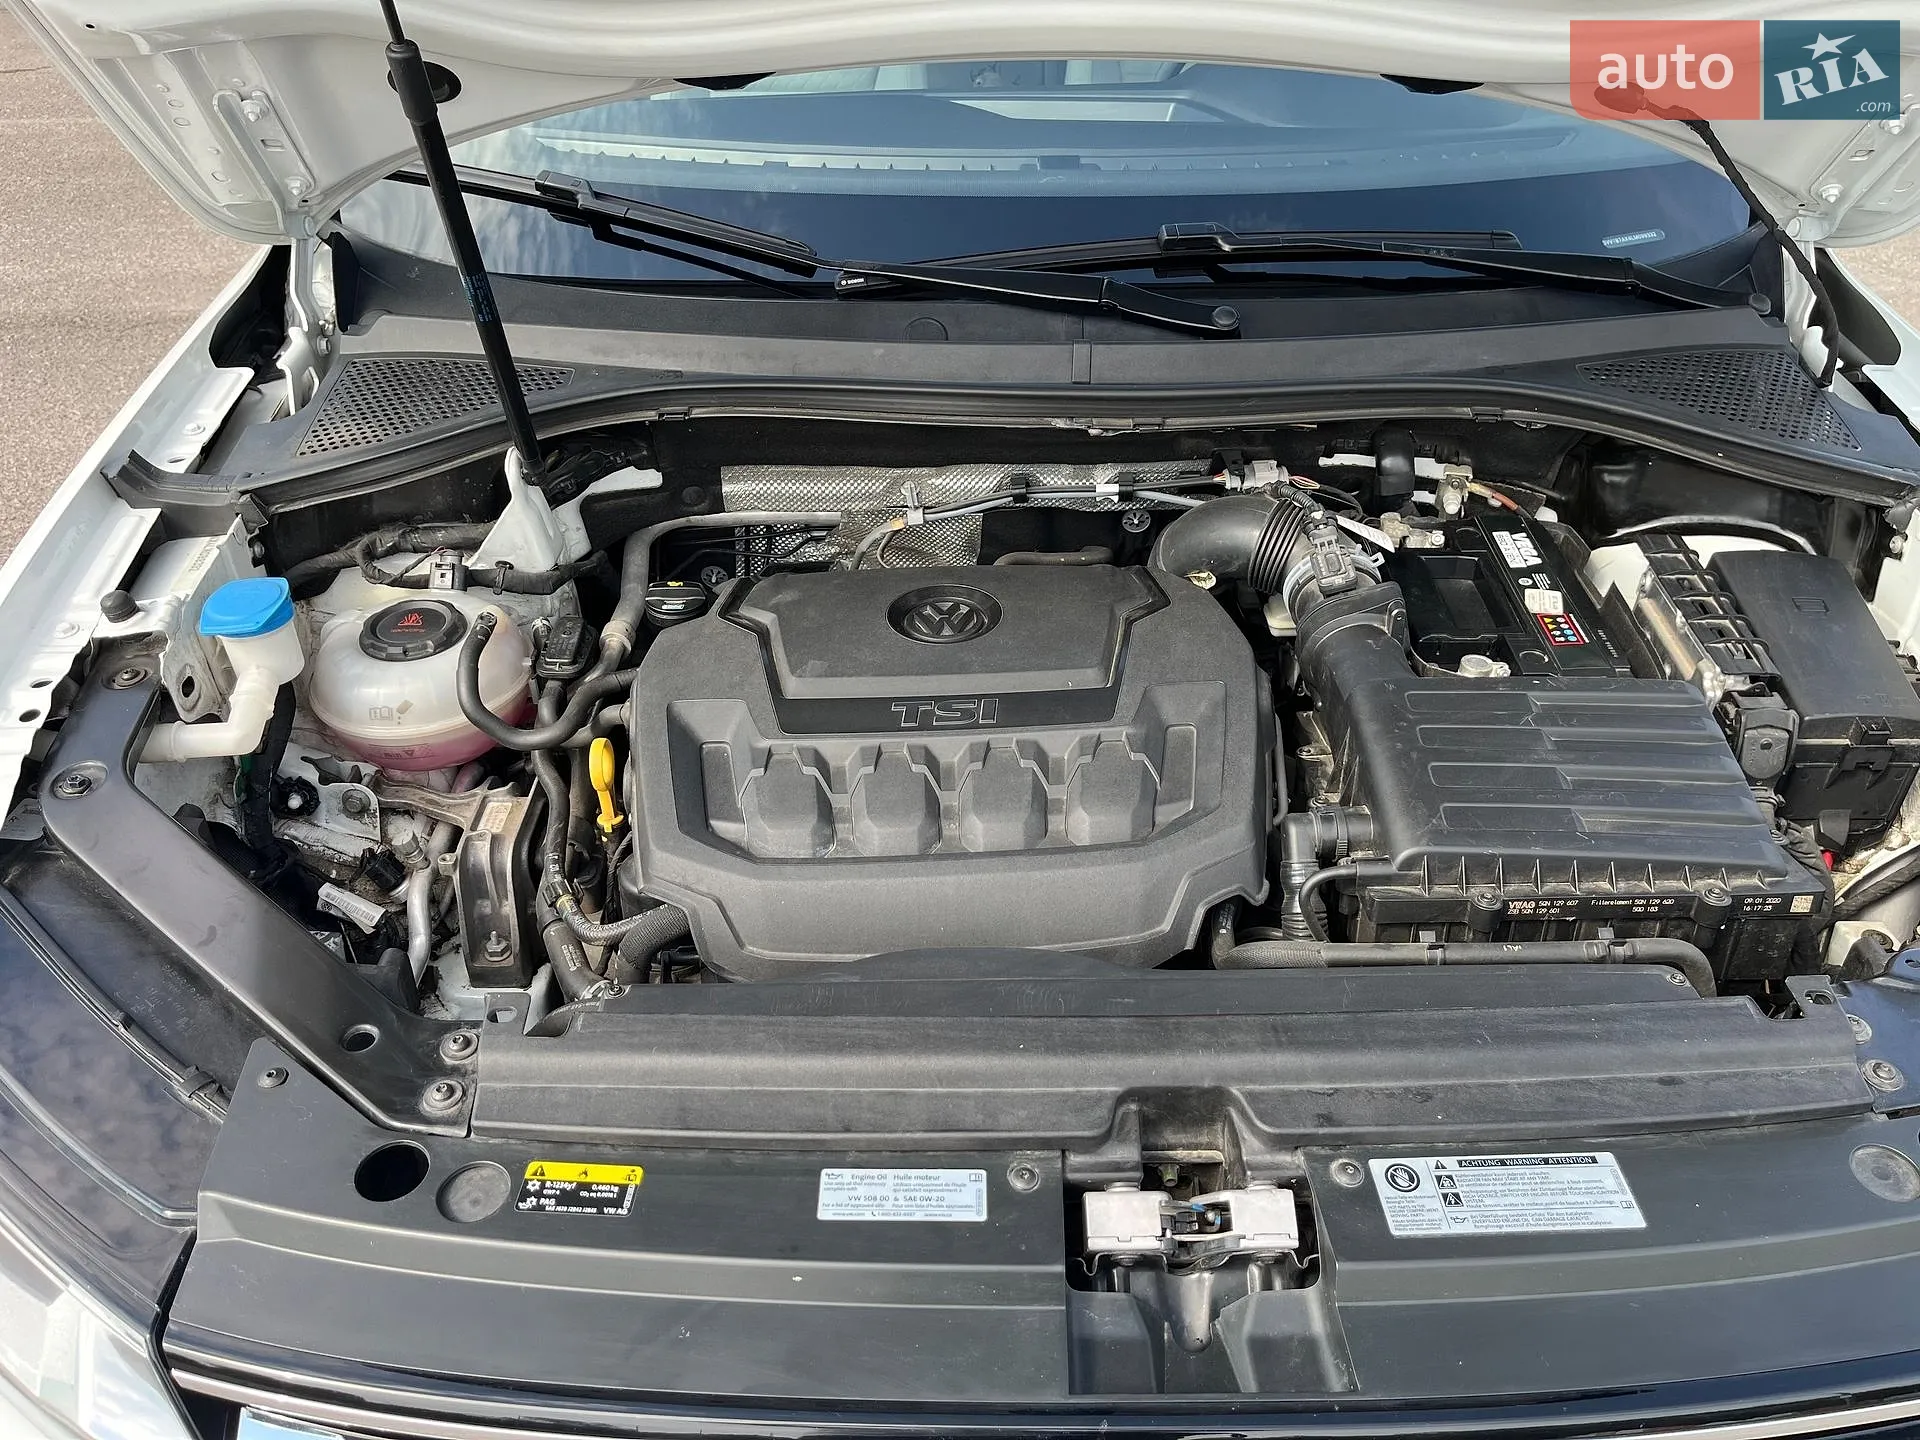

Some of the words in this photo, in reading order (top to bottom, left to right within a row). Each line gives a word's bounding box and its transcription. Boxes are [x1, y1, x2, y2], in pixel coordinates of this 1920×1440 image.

[891, 698, 998, 726] TSI
[1461, 1159, 1501, 1168] ACHTUNG
[1504, 1157, 1545, 1166] WARNING
[1548, 1156, 1593, 1165] ATTENTION
[545, 1181, 577, 1190] R-1234yf
[611, 1185, 619, 1193] kg
